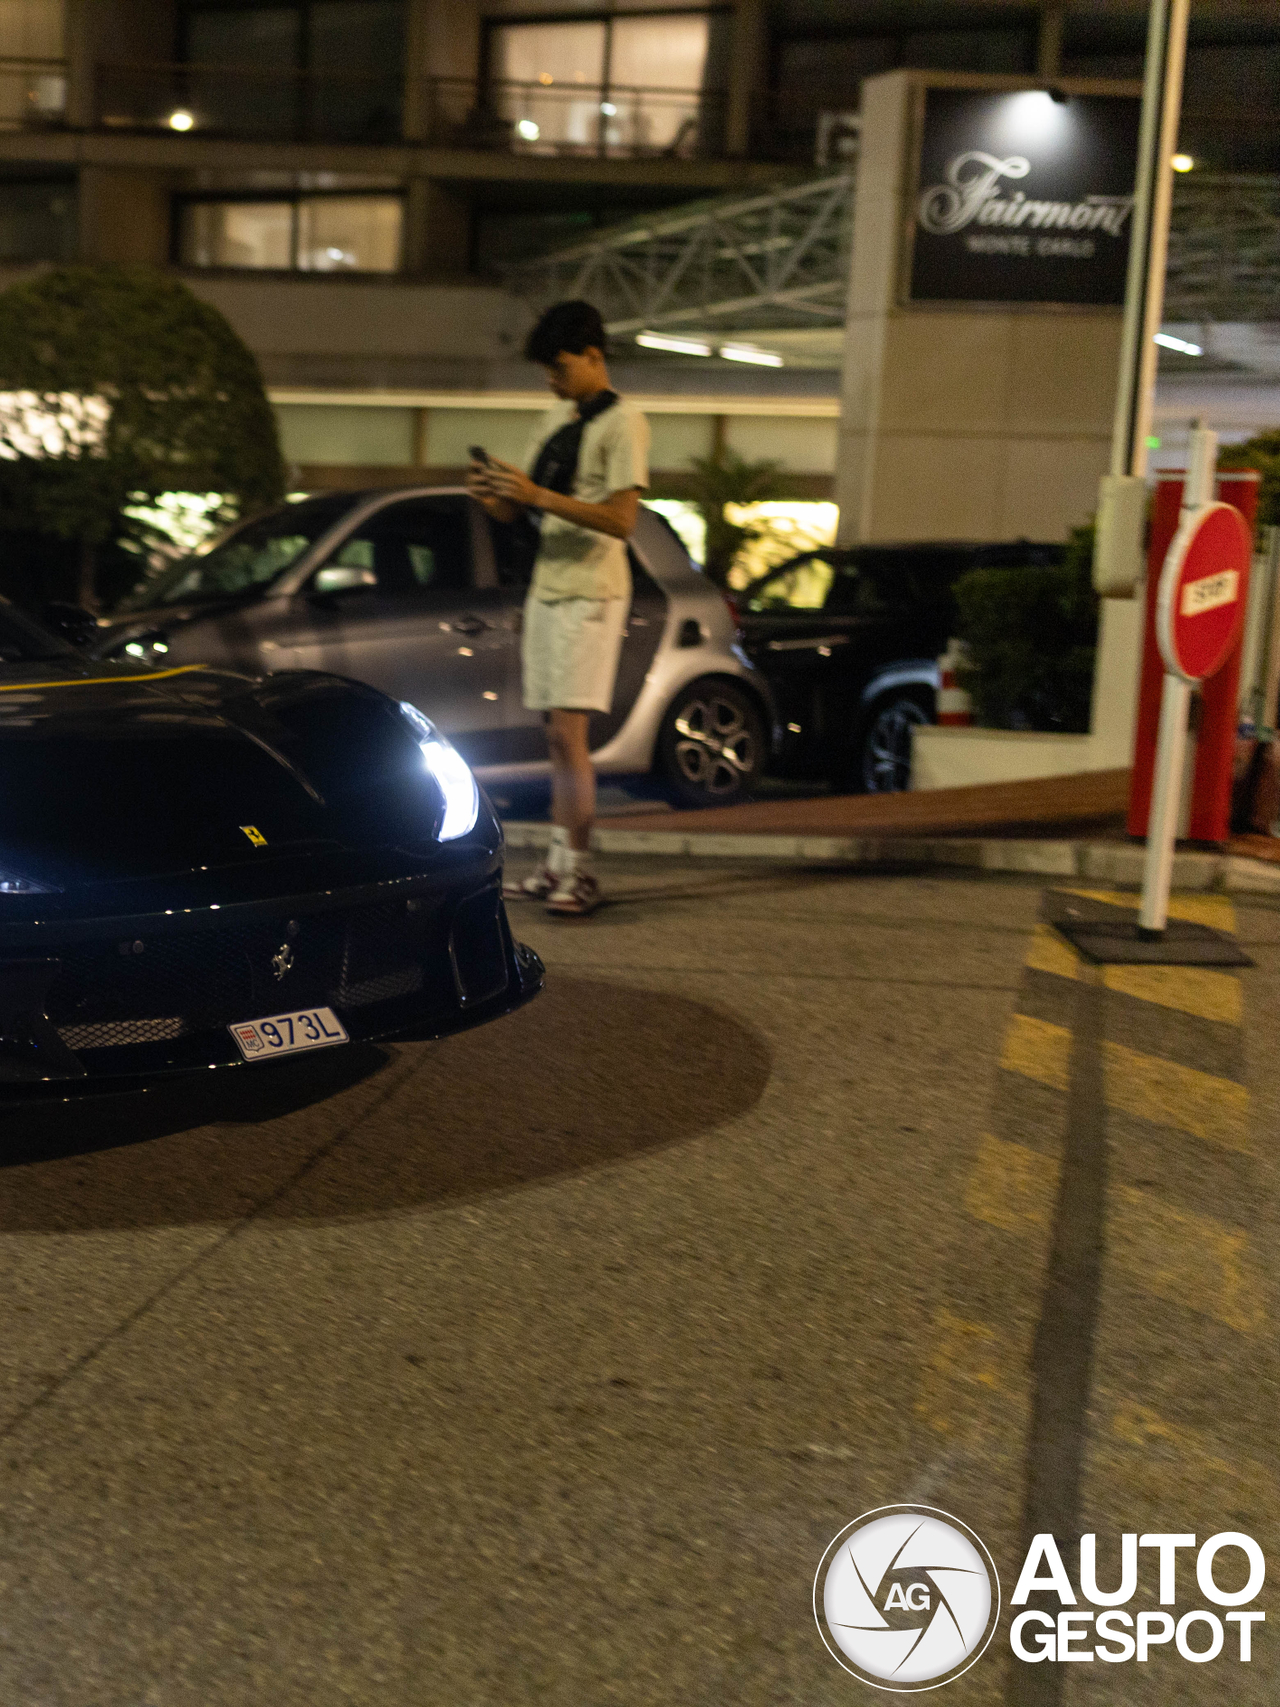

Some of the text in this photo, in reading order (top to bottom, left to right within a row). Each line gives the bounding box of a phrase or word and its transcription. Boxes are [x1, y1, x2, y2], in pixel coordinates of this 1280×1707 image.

[920, 150, 1136, 236] Fairmont
[246, 1039, 260, 1049] MC
[260, 1012, 341, 1047] 973L
